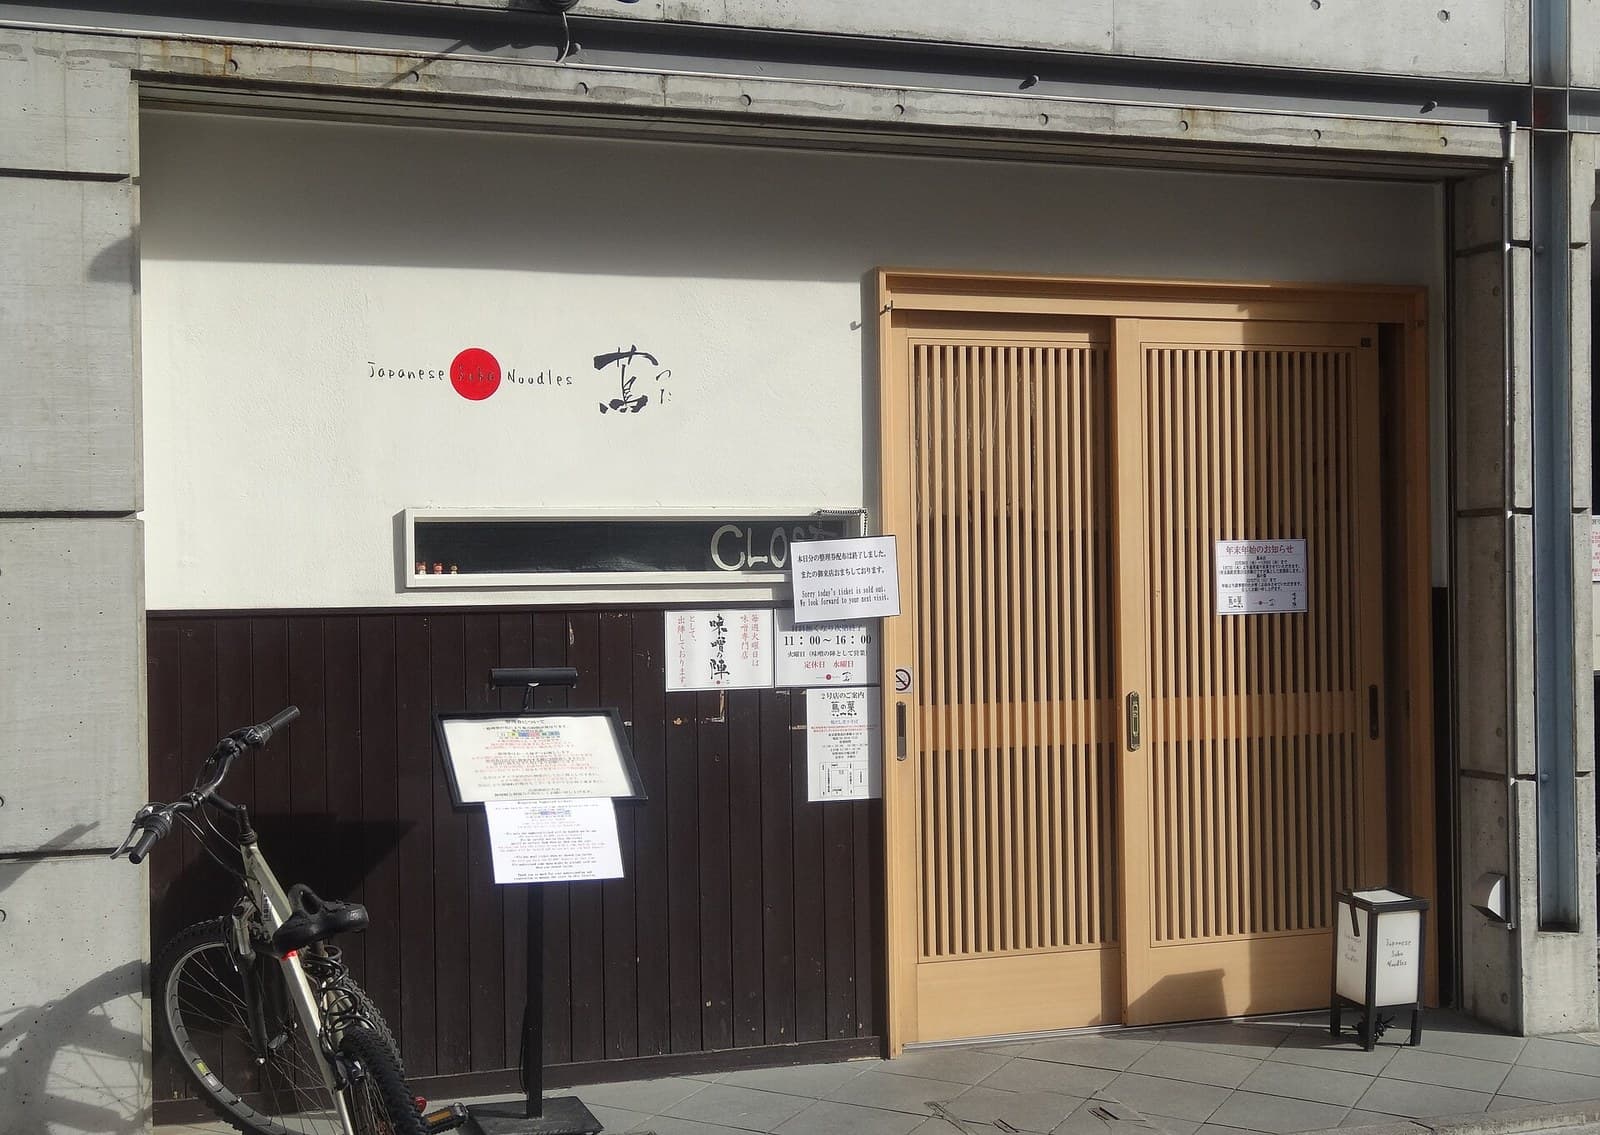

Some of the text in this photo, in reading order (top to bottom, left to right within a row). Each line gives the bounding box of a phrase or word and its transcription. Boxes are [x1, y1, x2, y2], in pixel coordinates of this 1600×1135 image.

[367, 361, 573, 386] Japanese Soba Noodles
[593, 345, 659, 414] 蔦
[1225, 544, 1294, 555] 年末年始のお知らせ
[801, 566, 885, 579] またの御来店おまちしております。
[802, 591, 815, 599] Sorry
[864, 585, 874, 594] sold
[808, 598, 819, 606] look
[821, 596, 840, 606] forward
